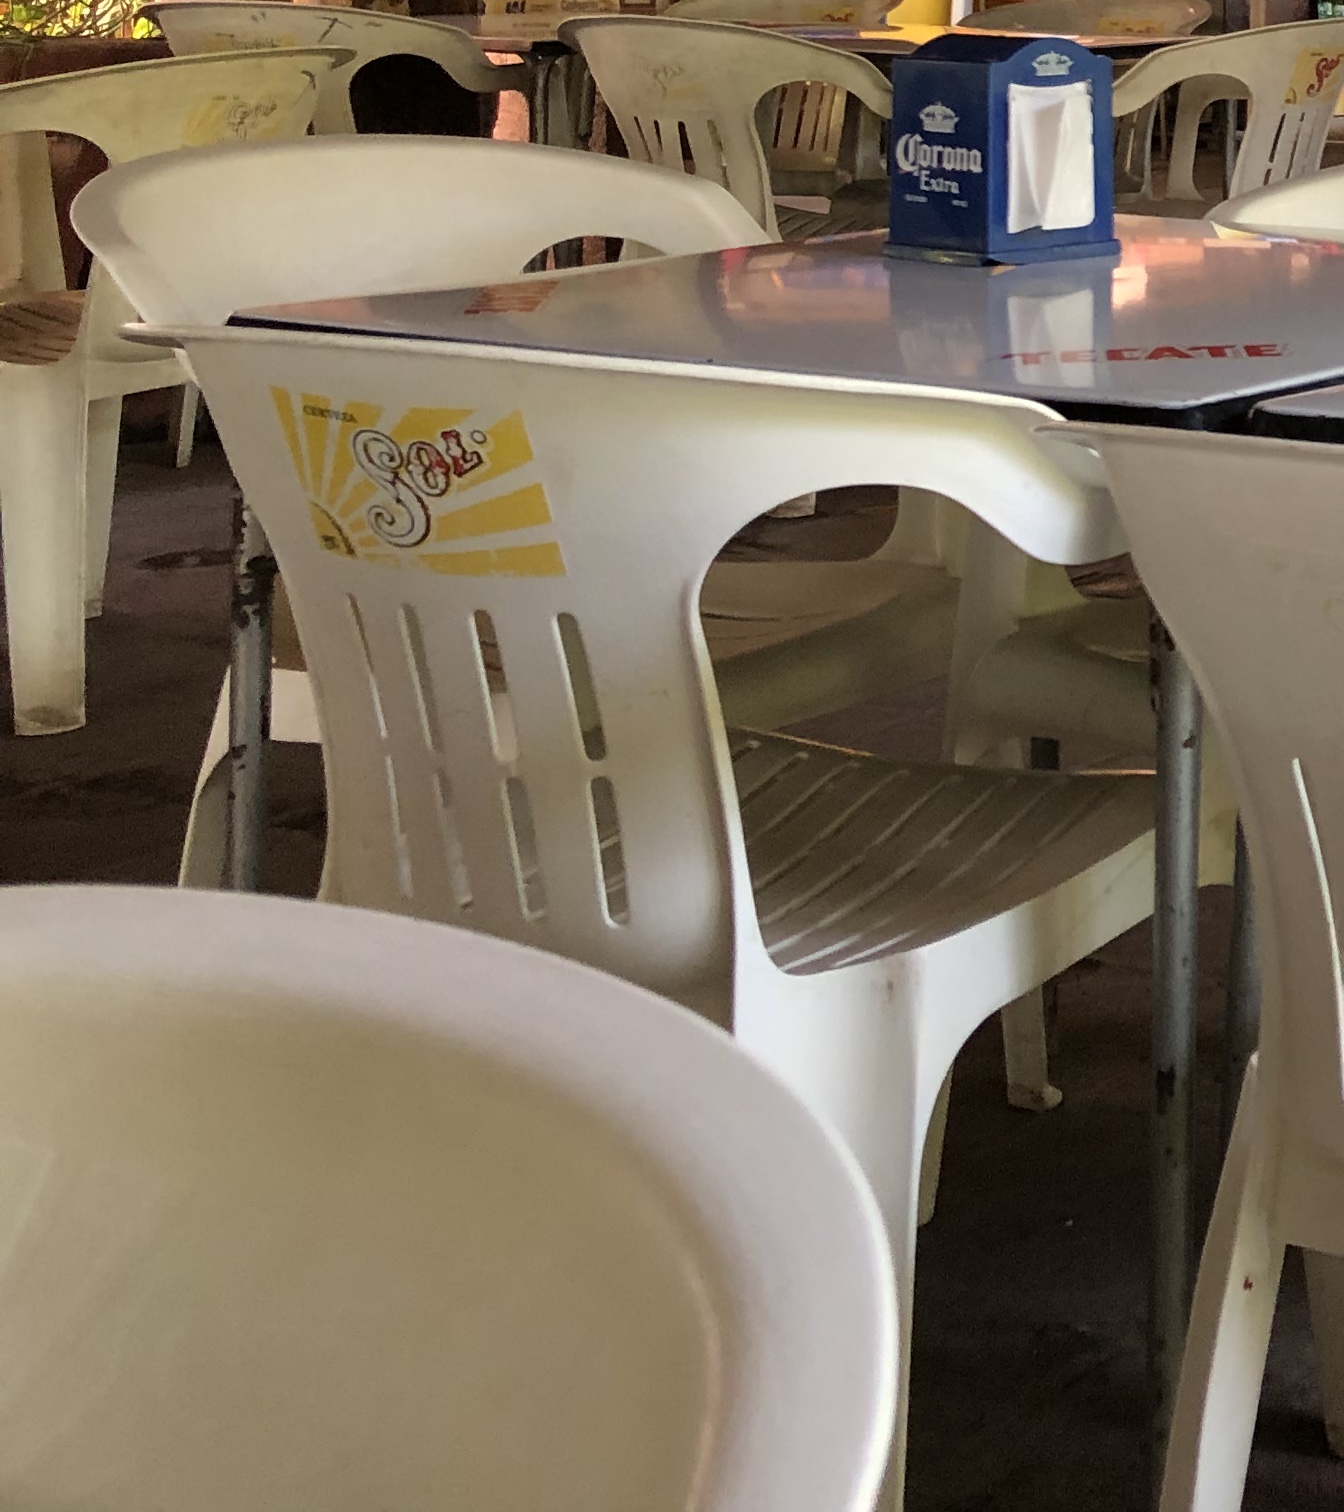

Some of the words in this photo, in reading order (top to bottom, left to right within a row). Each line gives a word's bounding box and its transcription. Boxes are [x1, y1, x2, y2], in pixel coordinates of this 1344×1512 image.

[896, 131, 983, 177] Corona
[919, 169, 960, 195] Extra
[1001, 344, 1284, 365] TECATE
